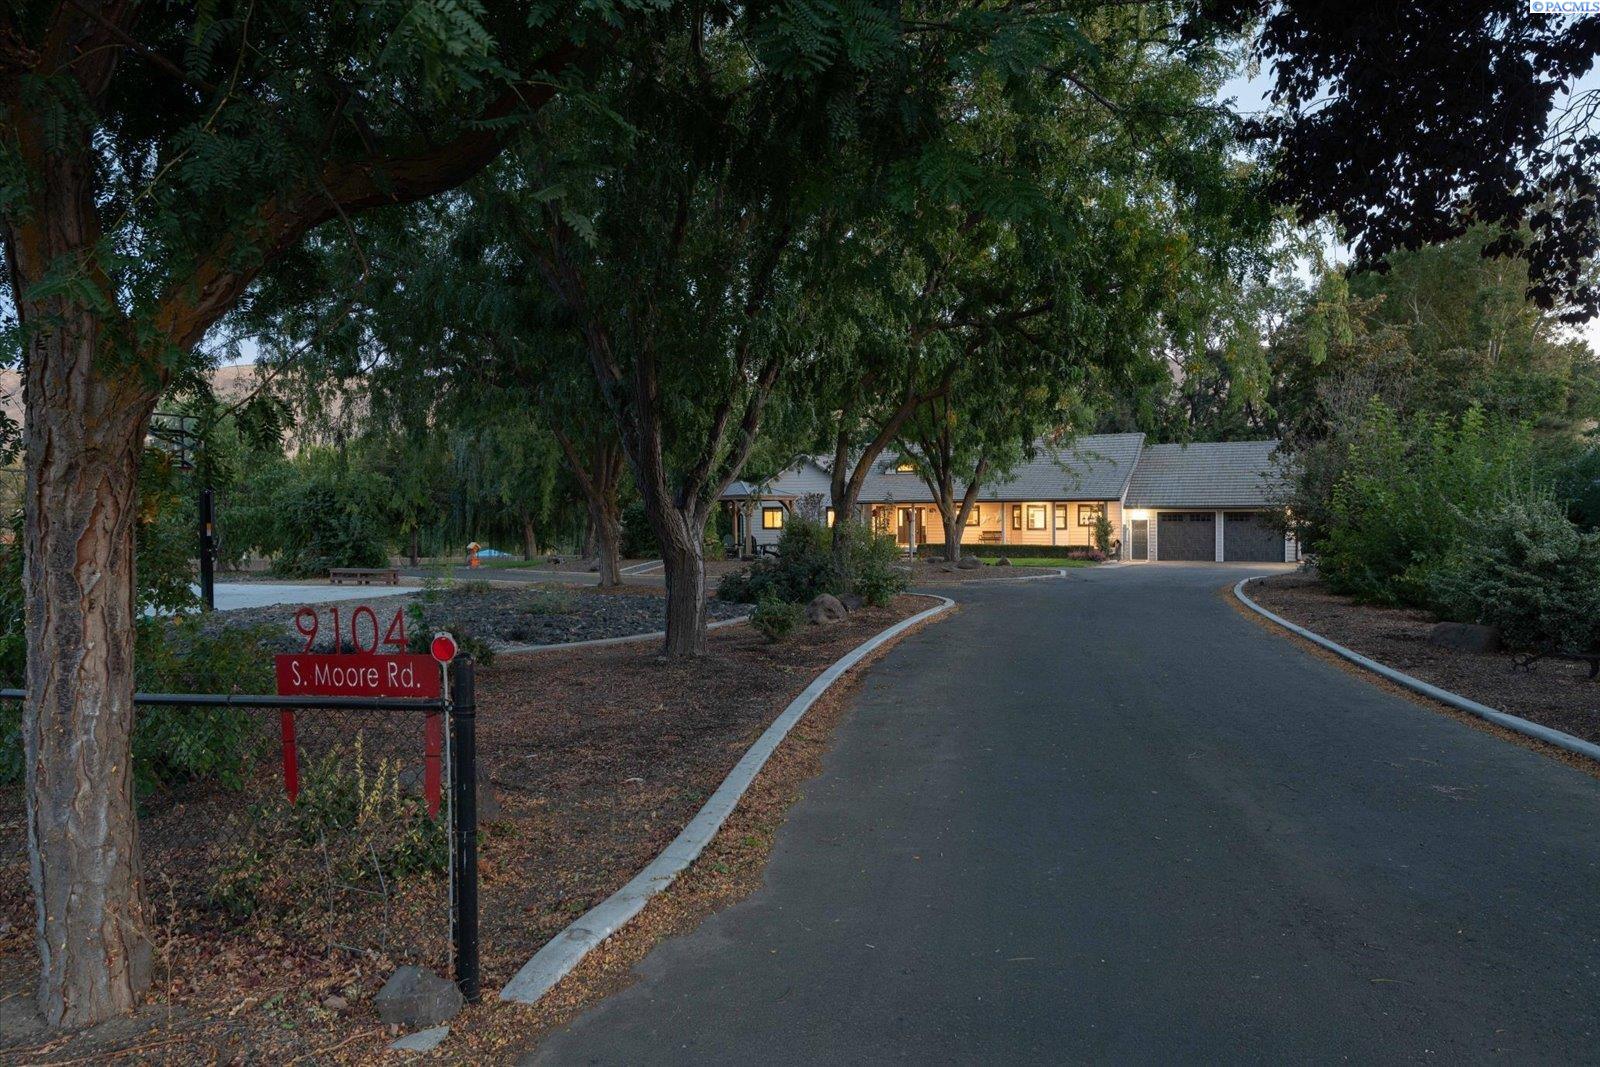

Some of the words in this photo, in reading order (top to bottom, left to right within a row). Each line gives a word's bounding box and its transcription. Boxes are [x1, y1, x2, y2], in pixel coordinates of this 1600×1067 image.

[295, 606, 409, 655] 9104
[291, 660, 308, 686] S.
[314, 663, 379, 688] Moore
[387, 661, 421, 688] Rd.
